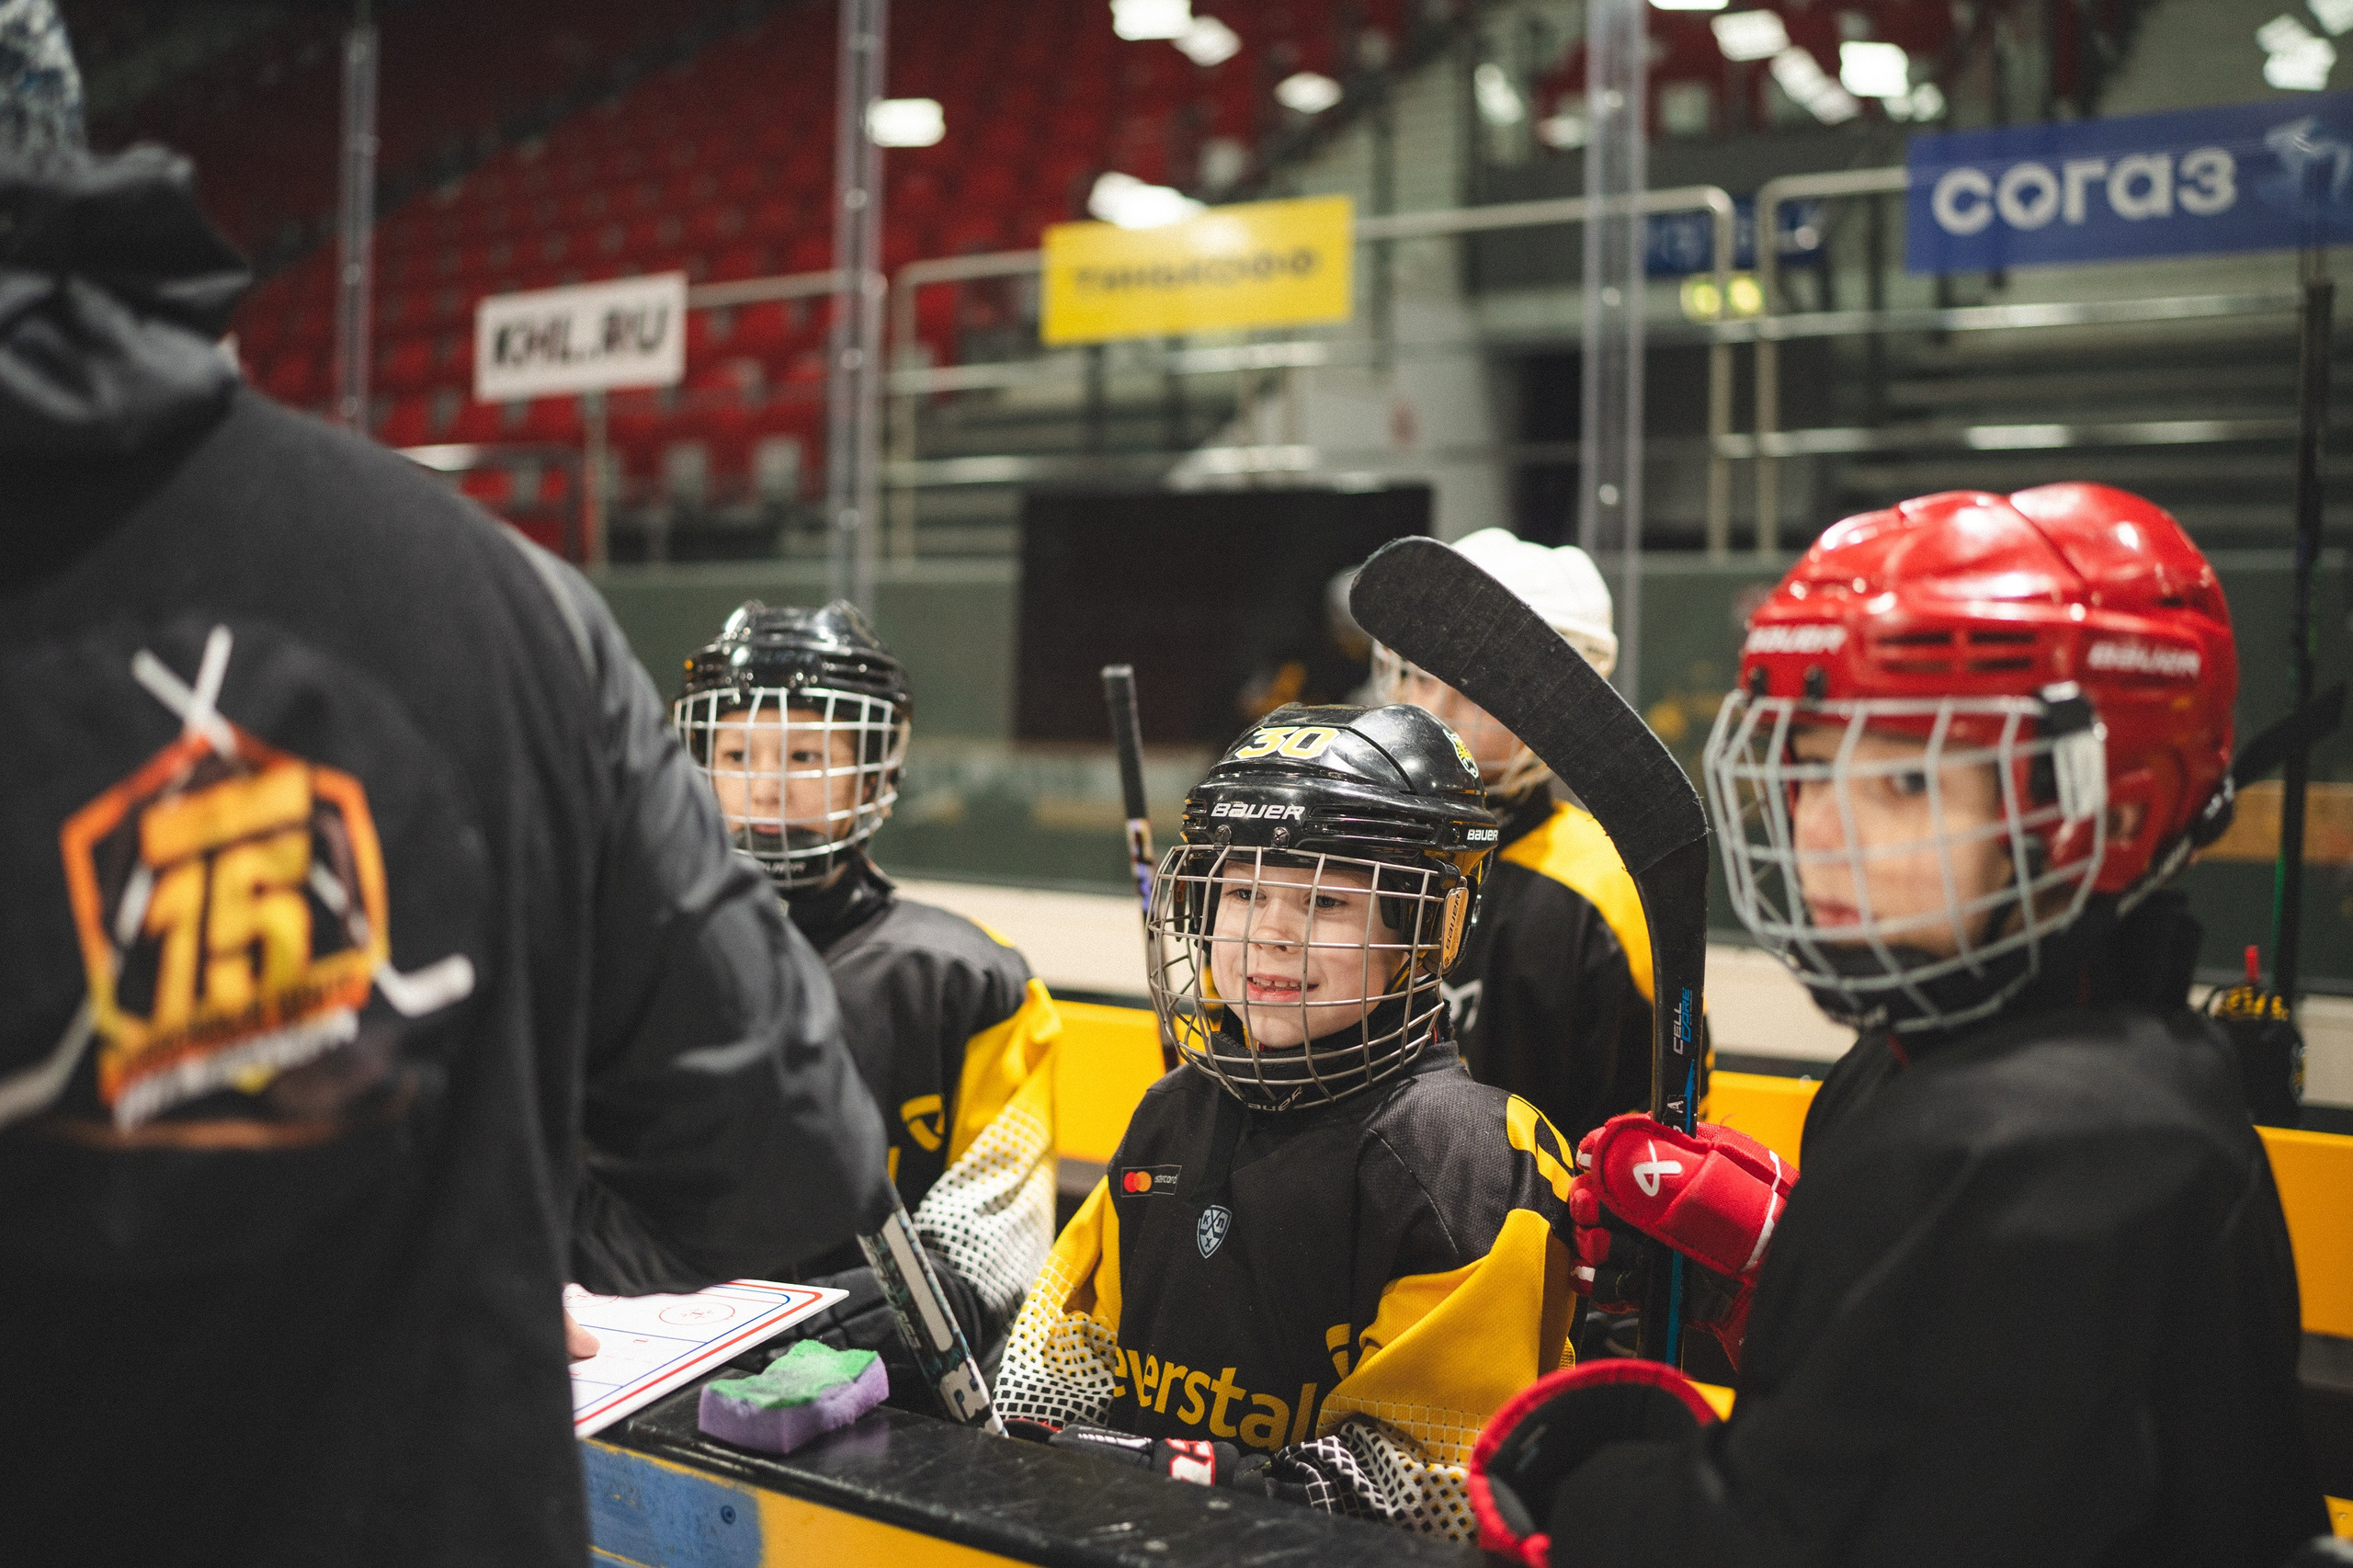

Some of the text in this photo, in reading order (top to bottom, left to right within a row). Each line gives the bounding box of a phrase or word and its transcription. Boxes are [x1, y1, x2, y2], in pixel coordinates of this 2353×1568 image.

[493, 301, 669, 366] KHL.RU
[1234, 726, 1341, 760] 30
[1211, 801, 1306, 821] BAUER
[1466, 828, 1499, 842] BAUER
[1673, 1002, 1684, 1056] CELL
[1113, 1346, 1318, 1453] everstal
